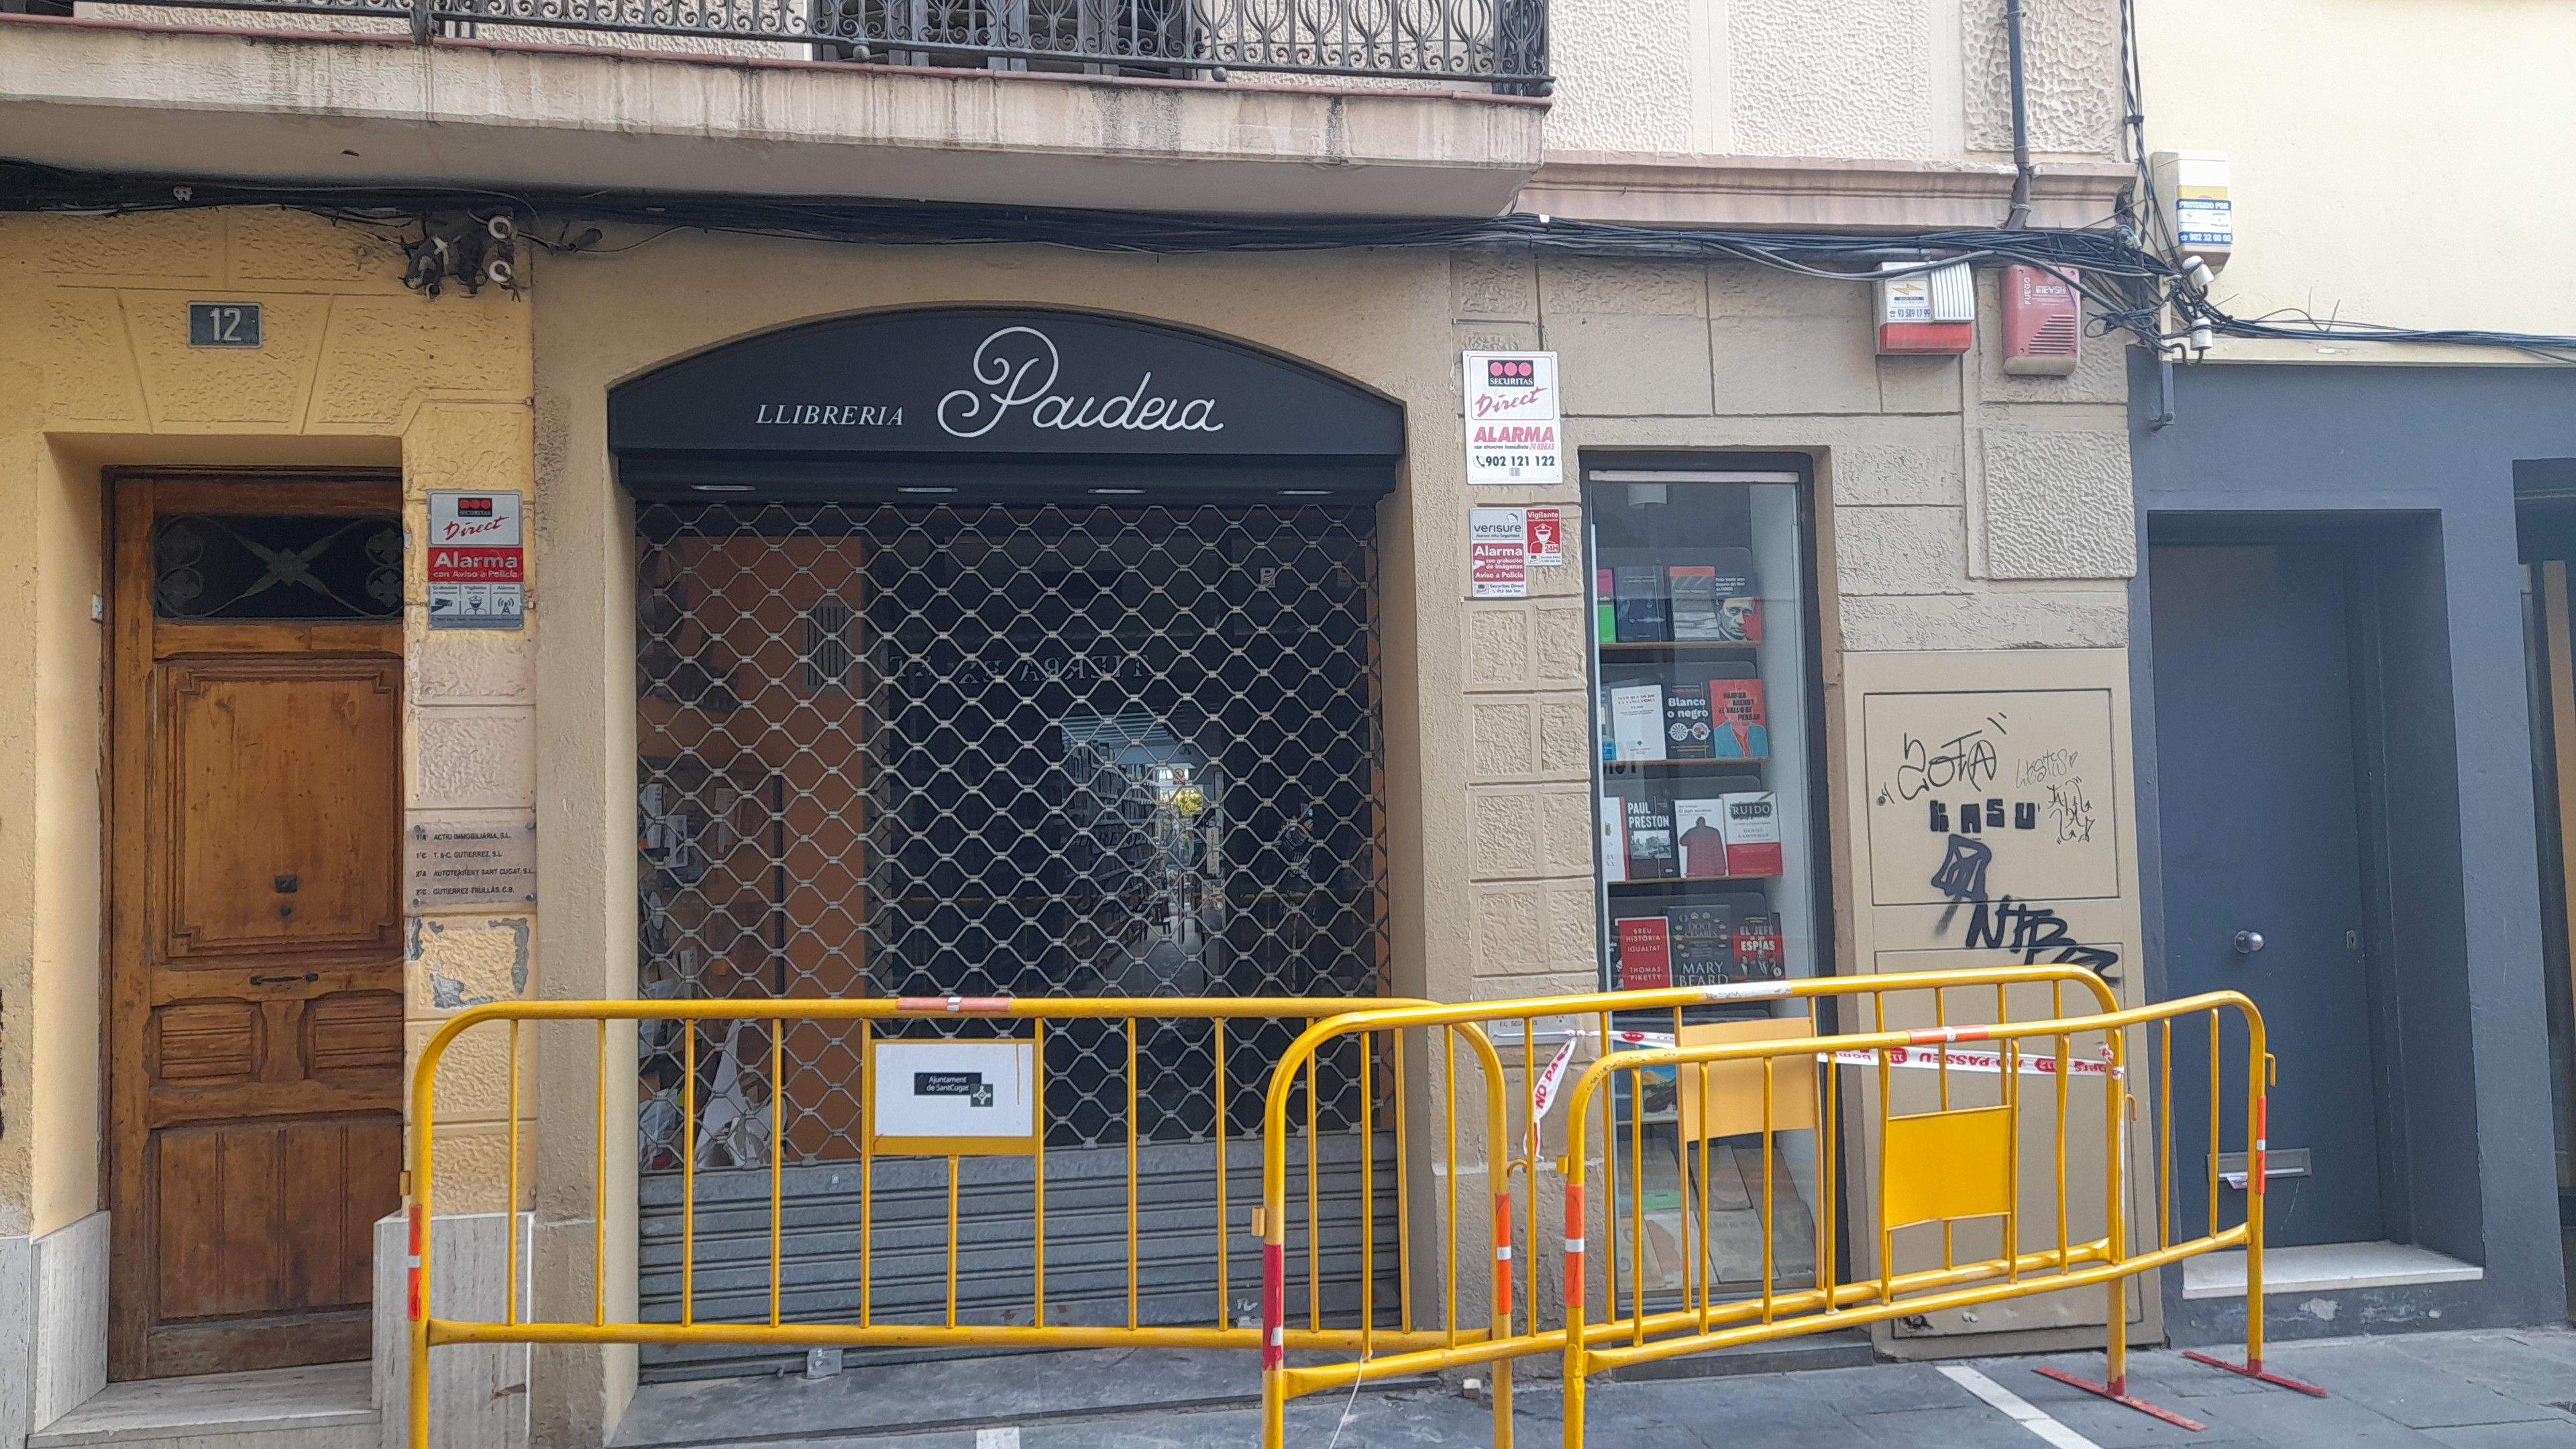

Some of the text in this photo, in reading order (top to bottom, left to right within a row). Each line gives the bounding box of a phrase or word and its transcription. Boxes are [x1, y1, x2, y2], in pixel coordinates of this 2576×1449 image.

[210, 307, 242, 341] 12
[756, 326, 1224, 438] LLIBRERIA Paideia
[1475, 386, 1548, 417] Direct
[1474, 426, 1554, 443] ALARMA
[1486, 455, 1555, 467] 902 121 122
[443, 516, 510, 541] Direct
[1474, 525, 1521, 533] verisure
[1474, 545, 1523, 556] Alarma
[434, 551, 518, 568] Alarma
[1668, 697, 1706, 707] Blanco
[1677, 709, 1709, 720] negro
[1627, 802, 1652, 814] PAUL
[1733, 804, 1770, 816] RUIDO
[1628, 815, 1670, 828] PRESTON
[1627, 945, 1660, 953] IGUALTAT
[1682, 961, 1724, 973] MARY
[1679, 974, 1729, 987] BEARD
[1919, 1052, 1990, 1067] PASSEU
[928, 1076, 967, 1084] Ajuntament
[1536, 1085, 1548, 1109] NO
